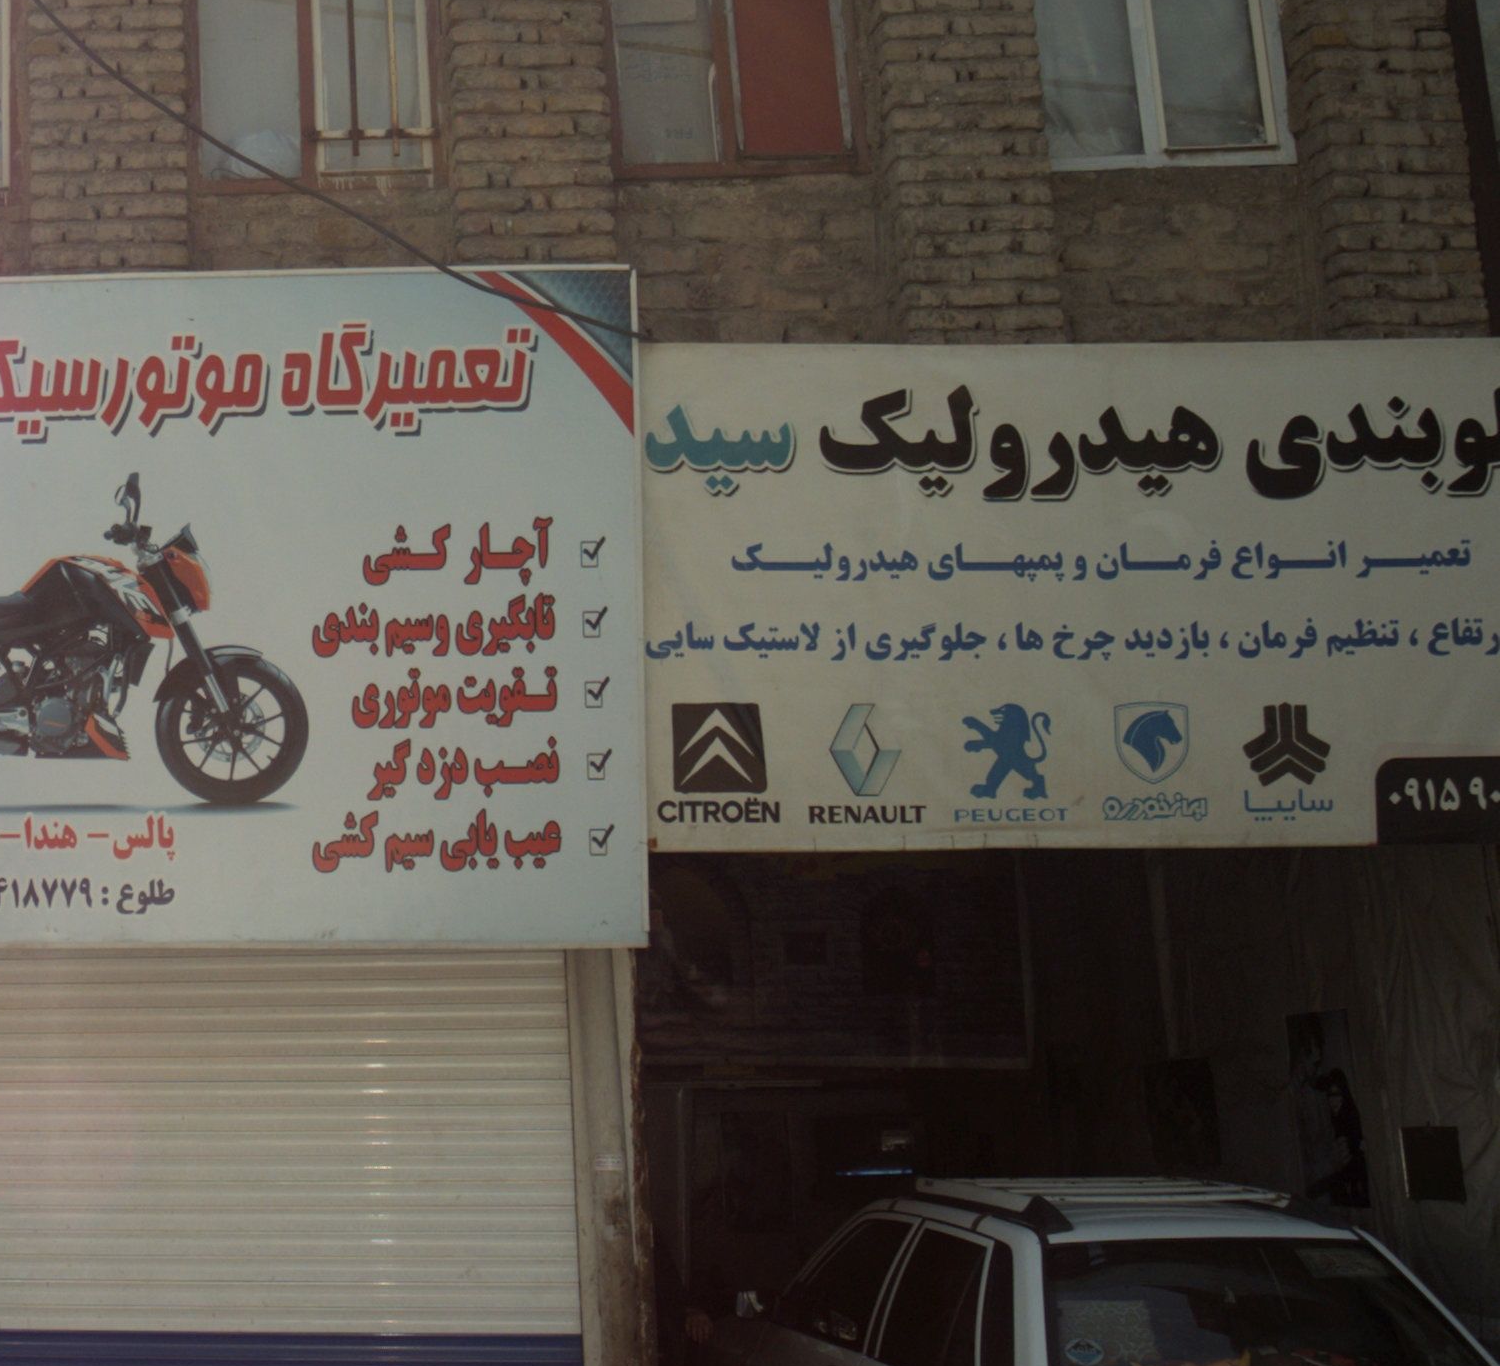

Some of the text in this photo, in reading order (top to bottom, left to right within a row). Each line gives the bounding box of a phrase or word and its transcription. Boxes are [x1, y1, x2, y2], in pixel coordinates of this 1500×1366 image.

[281, 323, 533, 431] تعمیرگاه
[645, 404, 793, 492] سید
[820, 384, 1220, 499] هیدرولیک
[363, 517, 553, 586] آچار کشی
[731, 540, 1471, 581] تعمیر انواع فرمان و پمپهای هیدرولیک
[312, 602, 380, 657] بندی
[455, 592, 555, 656] تابگیری
[645, 622, 714, 660] سایی
[723, 623, 820, 659] لاستیک
[831, 623, 856, 660] از
[865, 623, 987, 660] جلوگیری
[1052, 624, 1115, 660] چرخ
[1124, 621, 1209, 659] بازدید
[1237, 617, 1318, 659] فرمان
[1327, 619, 1400, 657] تنظیم
[352, 666, 557, 728] تقویت موتوری
[367, 736, 560, 800] نصب دزد گیر
[657, 798, 780, 824] CITROËN
[1243, 788, 1334, 821] سایپا
[1388, 776, 1461, 811] ۰۹۱۵
[809, 805, 927, 824] RENAULT
[954, 808, 1069, 823] PEUGEOT
[312, 809, 561, 873] عیب یابی سیم کشی
